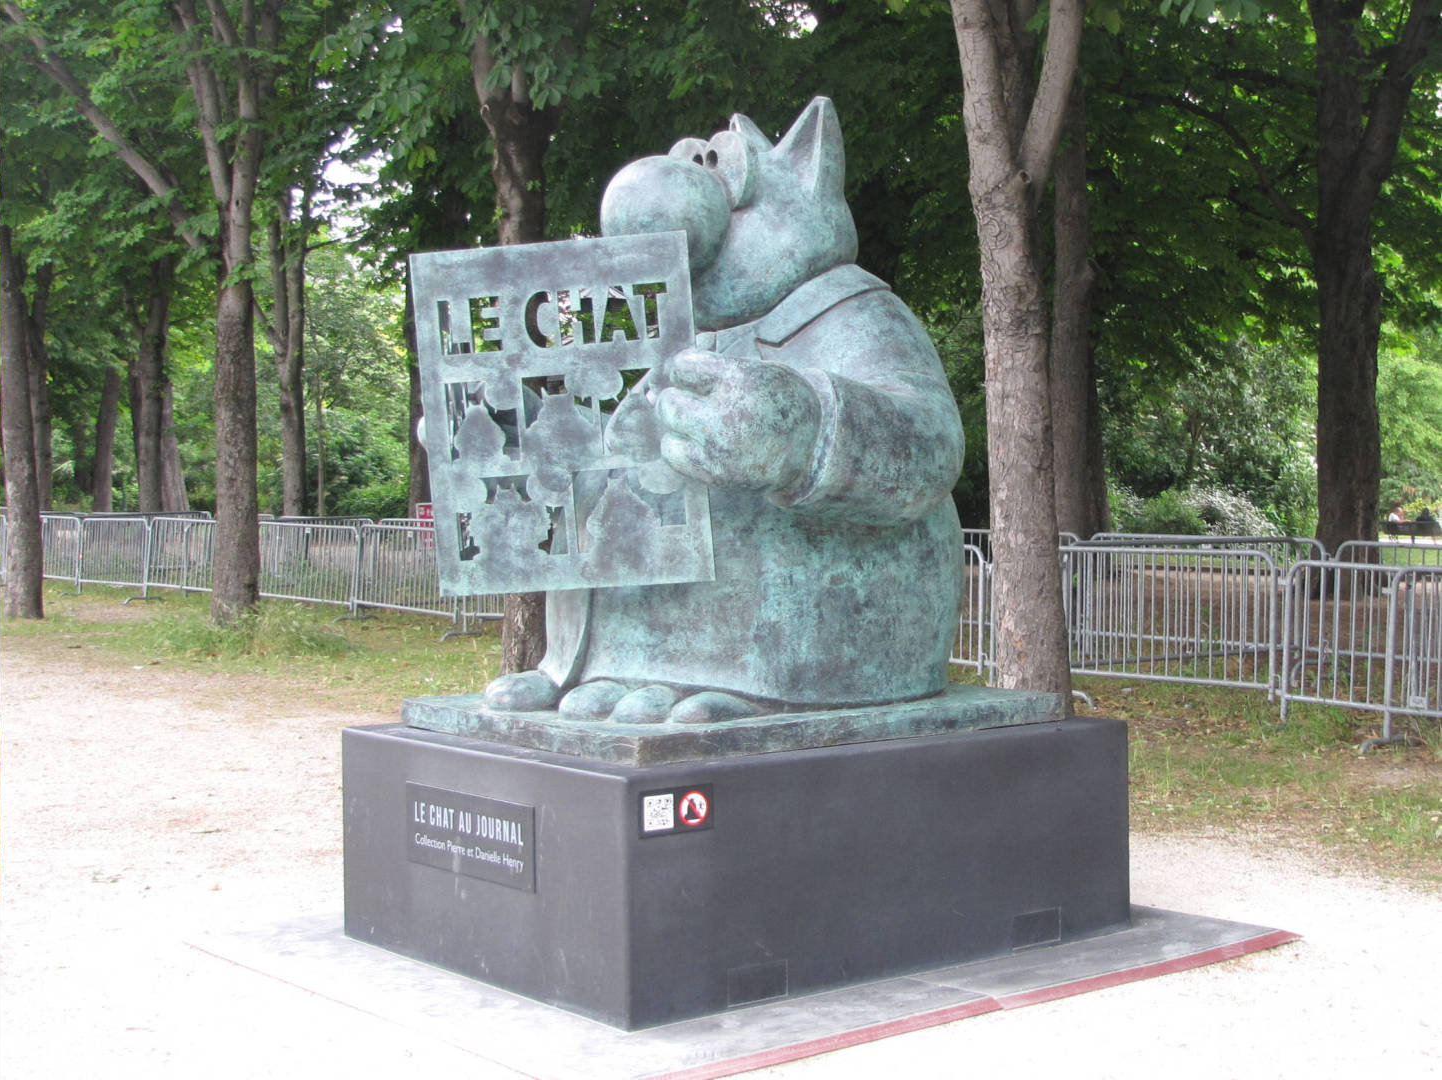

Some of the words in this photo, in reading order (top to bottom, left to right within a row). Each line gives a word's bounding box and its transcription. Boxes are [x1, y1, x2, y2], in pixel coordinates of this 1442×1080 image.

[437, 295, 503, 355] LE
[524, 281, 667, 348] CHAT
[414, 801, 427, 824] LE
[429, 804, 455, 830] CHAT
[458, 811, 472, 834] AU
[475, 814, 524, 846] JOURNAL
[415, 832, 446, 851] Collection
[447, 839, 466, 856] Pierre
[475, 846, 502, 864] Danielle
[502, 852, 525, 873] Henry
